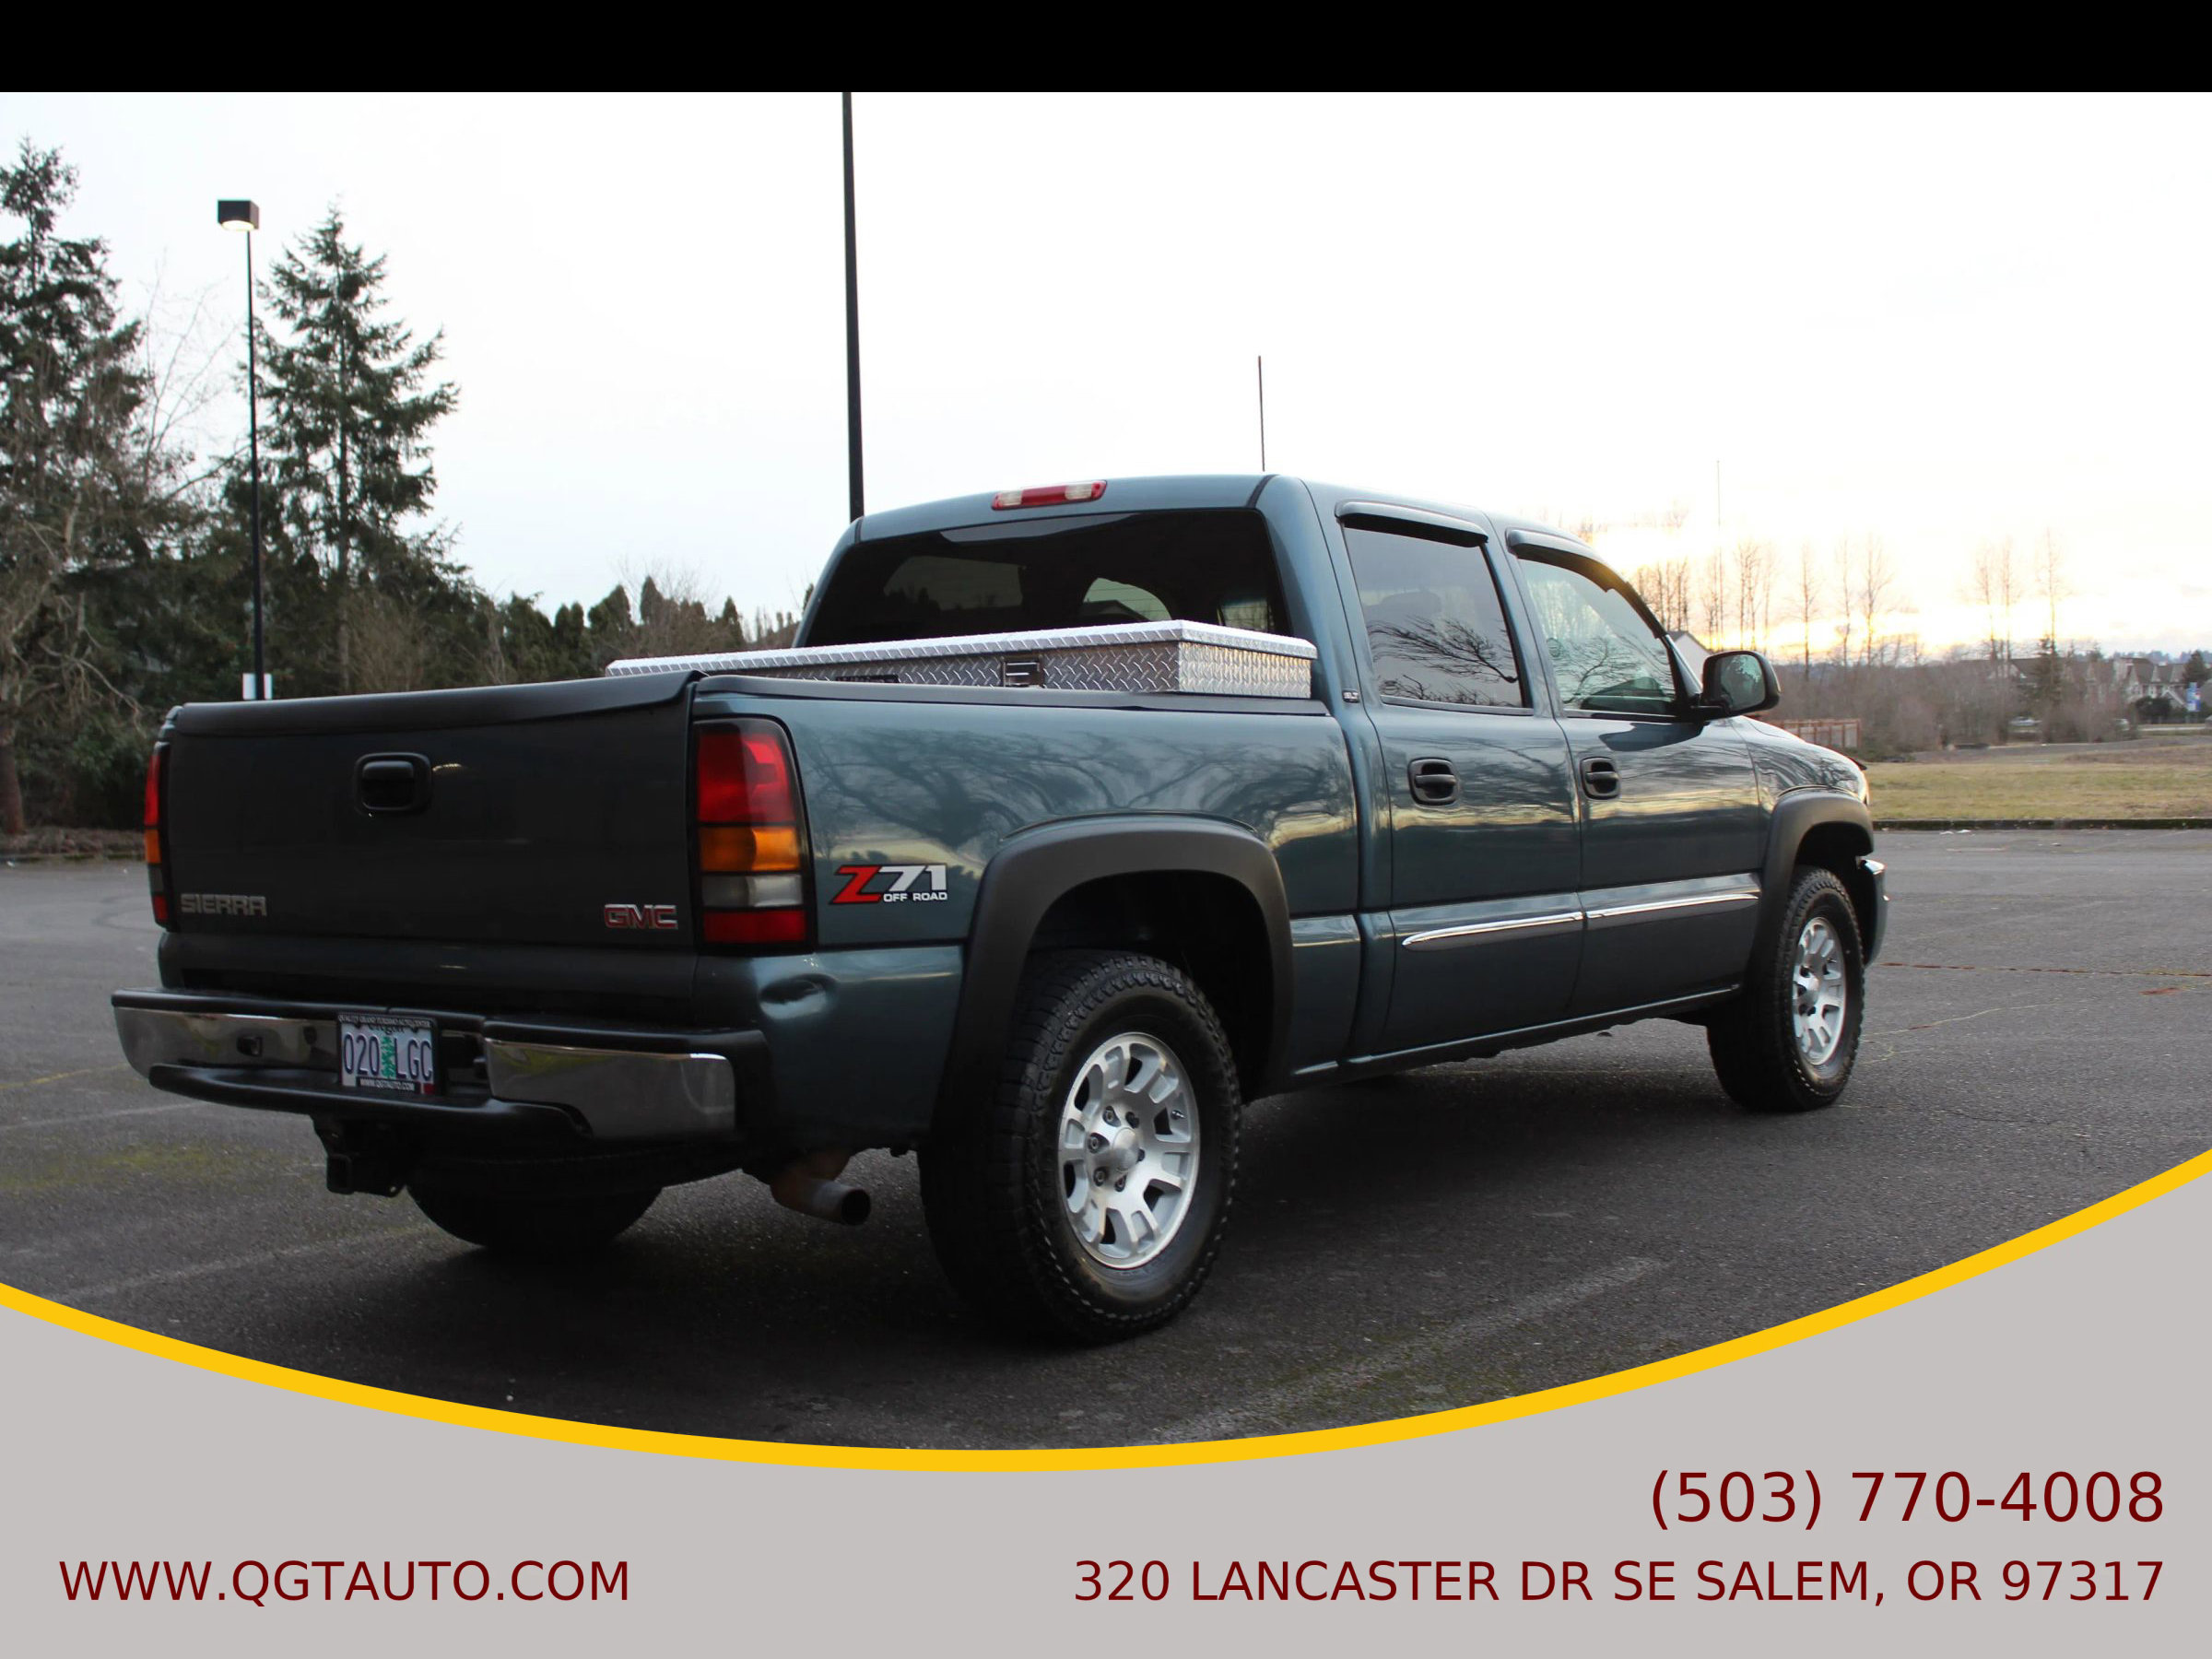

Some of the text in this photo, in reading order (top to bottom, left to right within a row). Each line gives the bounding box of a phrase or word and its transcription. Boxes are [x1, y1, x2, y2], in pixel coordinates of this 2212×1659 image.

[830, 865, 947, 903] Z71
[883, 891, 947, 902] OFF ROAD
[181, 893, 267, 916] SIERRA
[604, 903, 679, 929] GMC
[344, 1033, 432, 1080] 020 LGC
